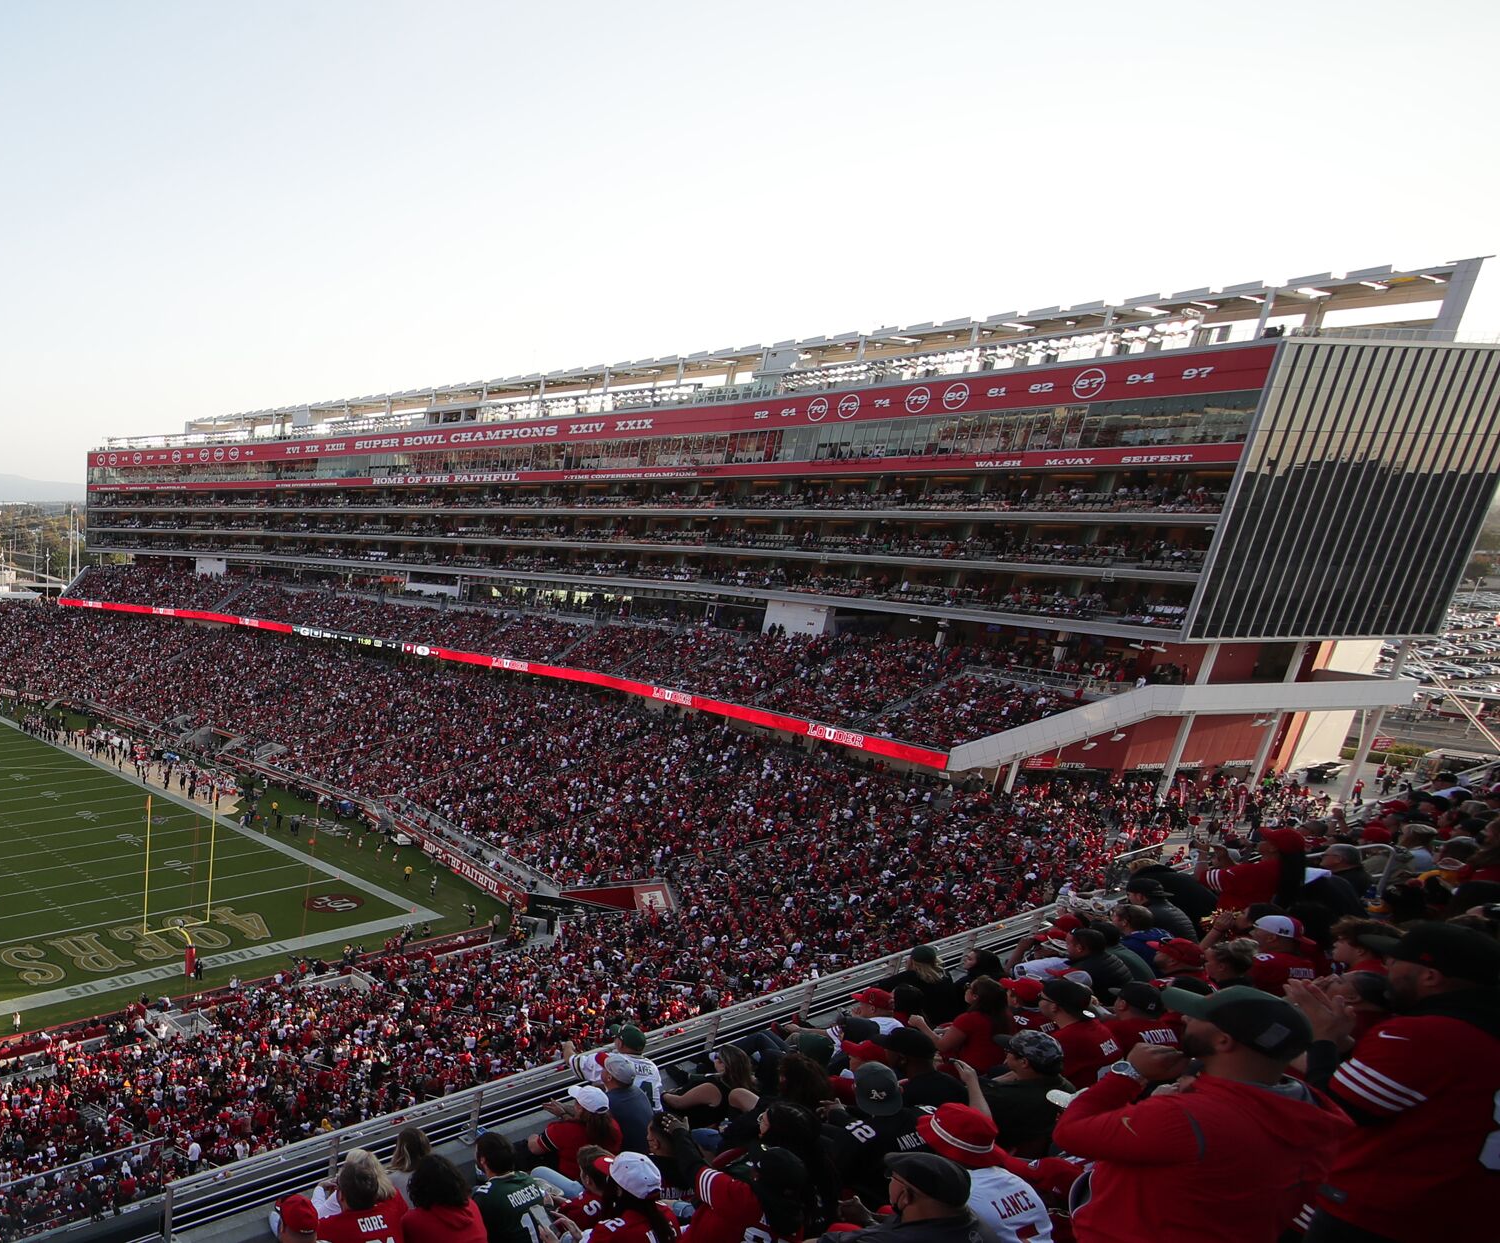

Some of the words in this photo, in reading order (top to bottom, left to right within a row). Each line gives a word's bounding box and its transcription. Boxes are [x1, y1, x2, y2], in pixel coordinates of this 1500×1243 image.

[1126, 372, 1156, 385] 94
[1182, 366, 1214, 381] 97
[986, 387, 1007, 397] 81
[1028, 382, 1055, 394] 82
[874, 398, 891, 408] 74
[754, 410, 769, 420] 52
[780, 407, 797, 417] 64
[286, 446, 300, 455] XVI
[305, 444, 320, 454] XIX
[325, 442, 346, 452] XXIII
[355, 438, 399, 451] SUPER
[403, 433, 447, 447] BOWL
[449, 425, 558, 444] CHAMPIONS
[568, 421, 606, 435] XXIV
[615, 418, 654, 432] XXIX
[975, 460, 1022, 468] WALSH
[1044, 457, 1095, 467] McVAY
[1121, 454, 1193, 465] SEIFERT
[372, 476, 405, 485] HOME
[407, 476, 422, 484] OF
[425, 475, 450, 483] THE
[453, 473, 519, 483] FAITHFUL
[590, 471, 643, 479] CONFERENCE
[644, 470, 698, 478] CHAMPIONS
[357, 637, 372, 646] 11:00
[492, 657, 529, 672] LOUDER
[652, 686, 692, 706] LOUDER
[807, 722, 864, 748] LOUDER
[116, 832, 143, 847] 20
[163, 859, 194, 875] 10
[446, 852, 461, 869] THE
[461, 861, 499, 894] FAITHFUL
[104, 974, 135, 986] OF
[65, 982, 99, 997] US
[1139, 1028, 1179, 1045] MONTAN
[1100, 1038, 1119, 1057] BOSA
[844, 1118, 877, 1144] 32
[896, 1131, 926, 1152] ANDER
[506, 1183, 541, 1209] RODGERS
[990, 1190, 1036, 1220] LANCE
[357, 1214, 388, 1233] GORE
